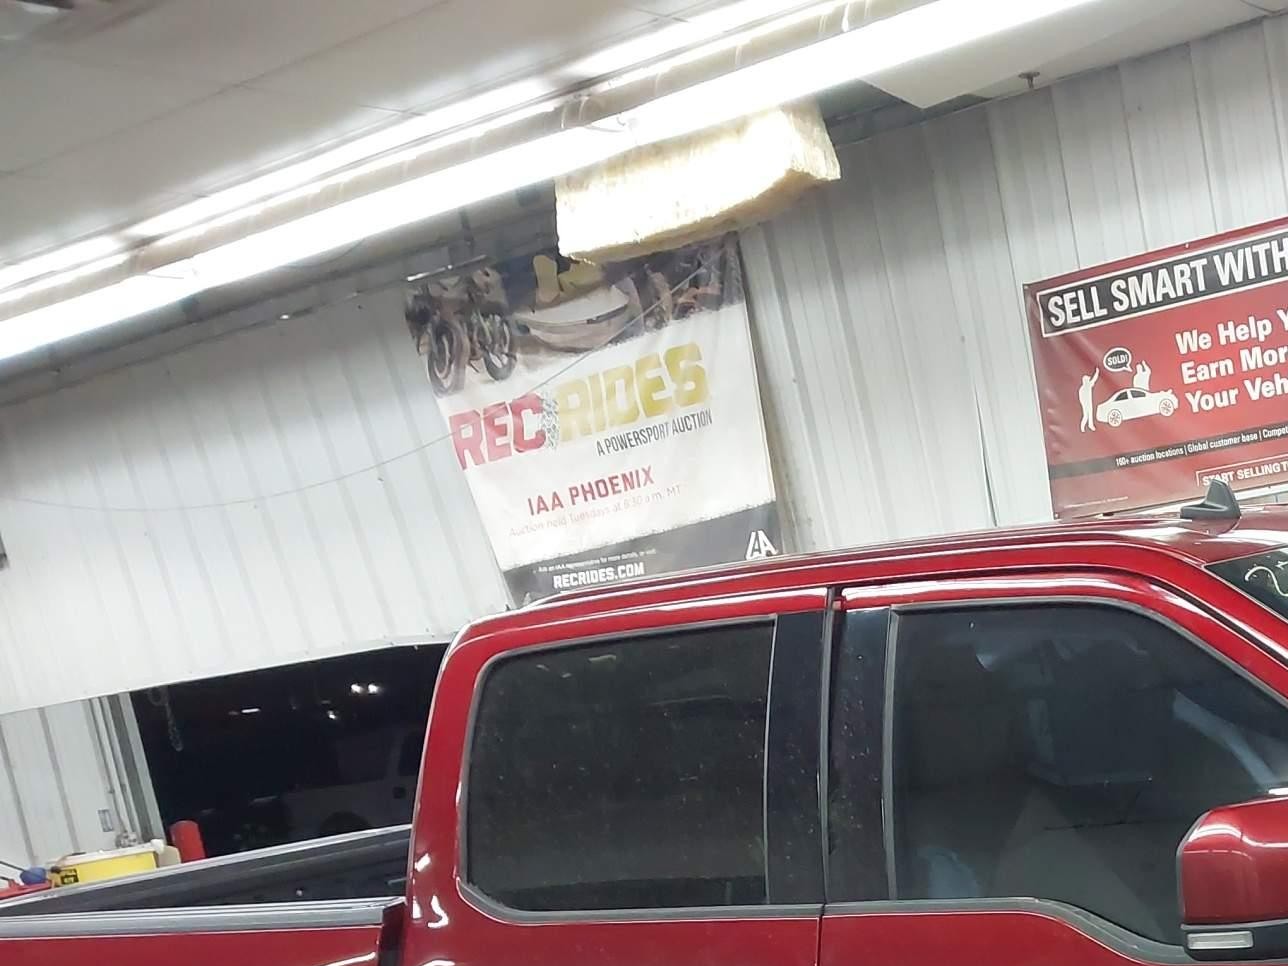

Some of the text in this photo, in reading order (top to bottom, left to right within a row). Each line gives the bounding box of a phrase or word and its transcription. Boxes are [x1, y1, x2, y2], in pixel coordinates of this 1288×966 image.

[1048, 286, 1108, 328] SELL
[1110, 259, 1209, 312] SMART
[1175, 329, 1212, 355] We
[1217, 315, 1273, 347] Help
[1107, 354, 1128, 366] SOLD!
[1181, 357, 1235, 385] Earn
[449, 342, 710, 469] REC RIDES
[1185, 387, 1240, 413] Your
[596, 408, 713, 456] A POWERSPORT AUCTION
[1130, 452, 1155, 464] auction
[1155, 446, 1184, 459] locations
[1187, 441, 1209, 453] Global
[1209, 435, 1240, 449] customer
[1241, 433, 1258, 443] base
[1237, 463, 1281, 479] SELLING
[527, 466, 654, 516] IAA PHOENIX
[553, 562, 645, 589] RECRIDES.COM
